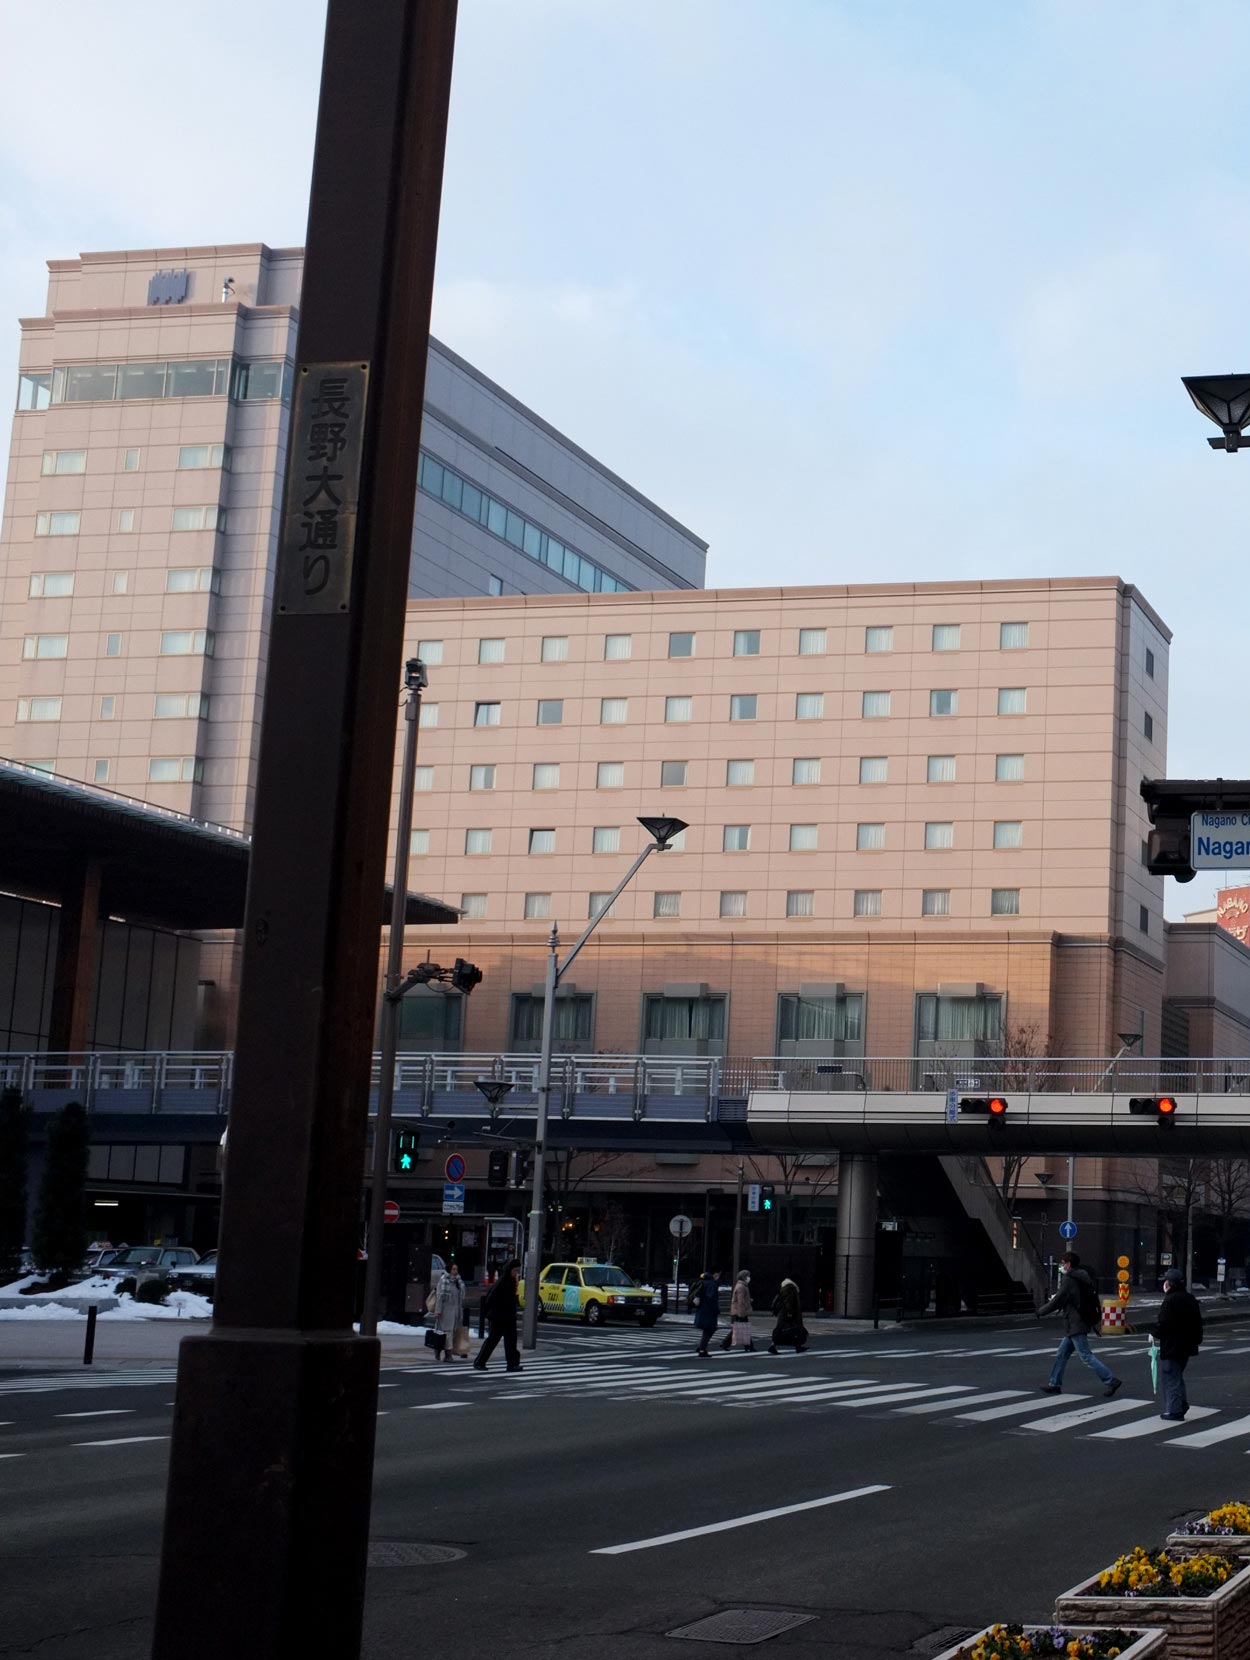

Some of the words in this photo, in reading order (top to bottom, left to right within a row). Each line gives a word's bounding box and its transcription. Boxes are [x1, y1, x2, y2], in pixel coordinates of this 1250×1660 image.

[302, 377, 351, 596] 長野大通り
[1202, 814, 1237, 828] Nagano
[548, 1292, 559, 1302] TAXI
